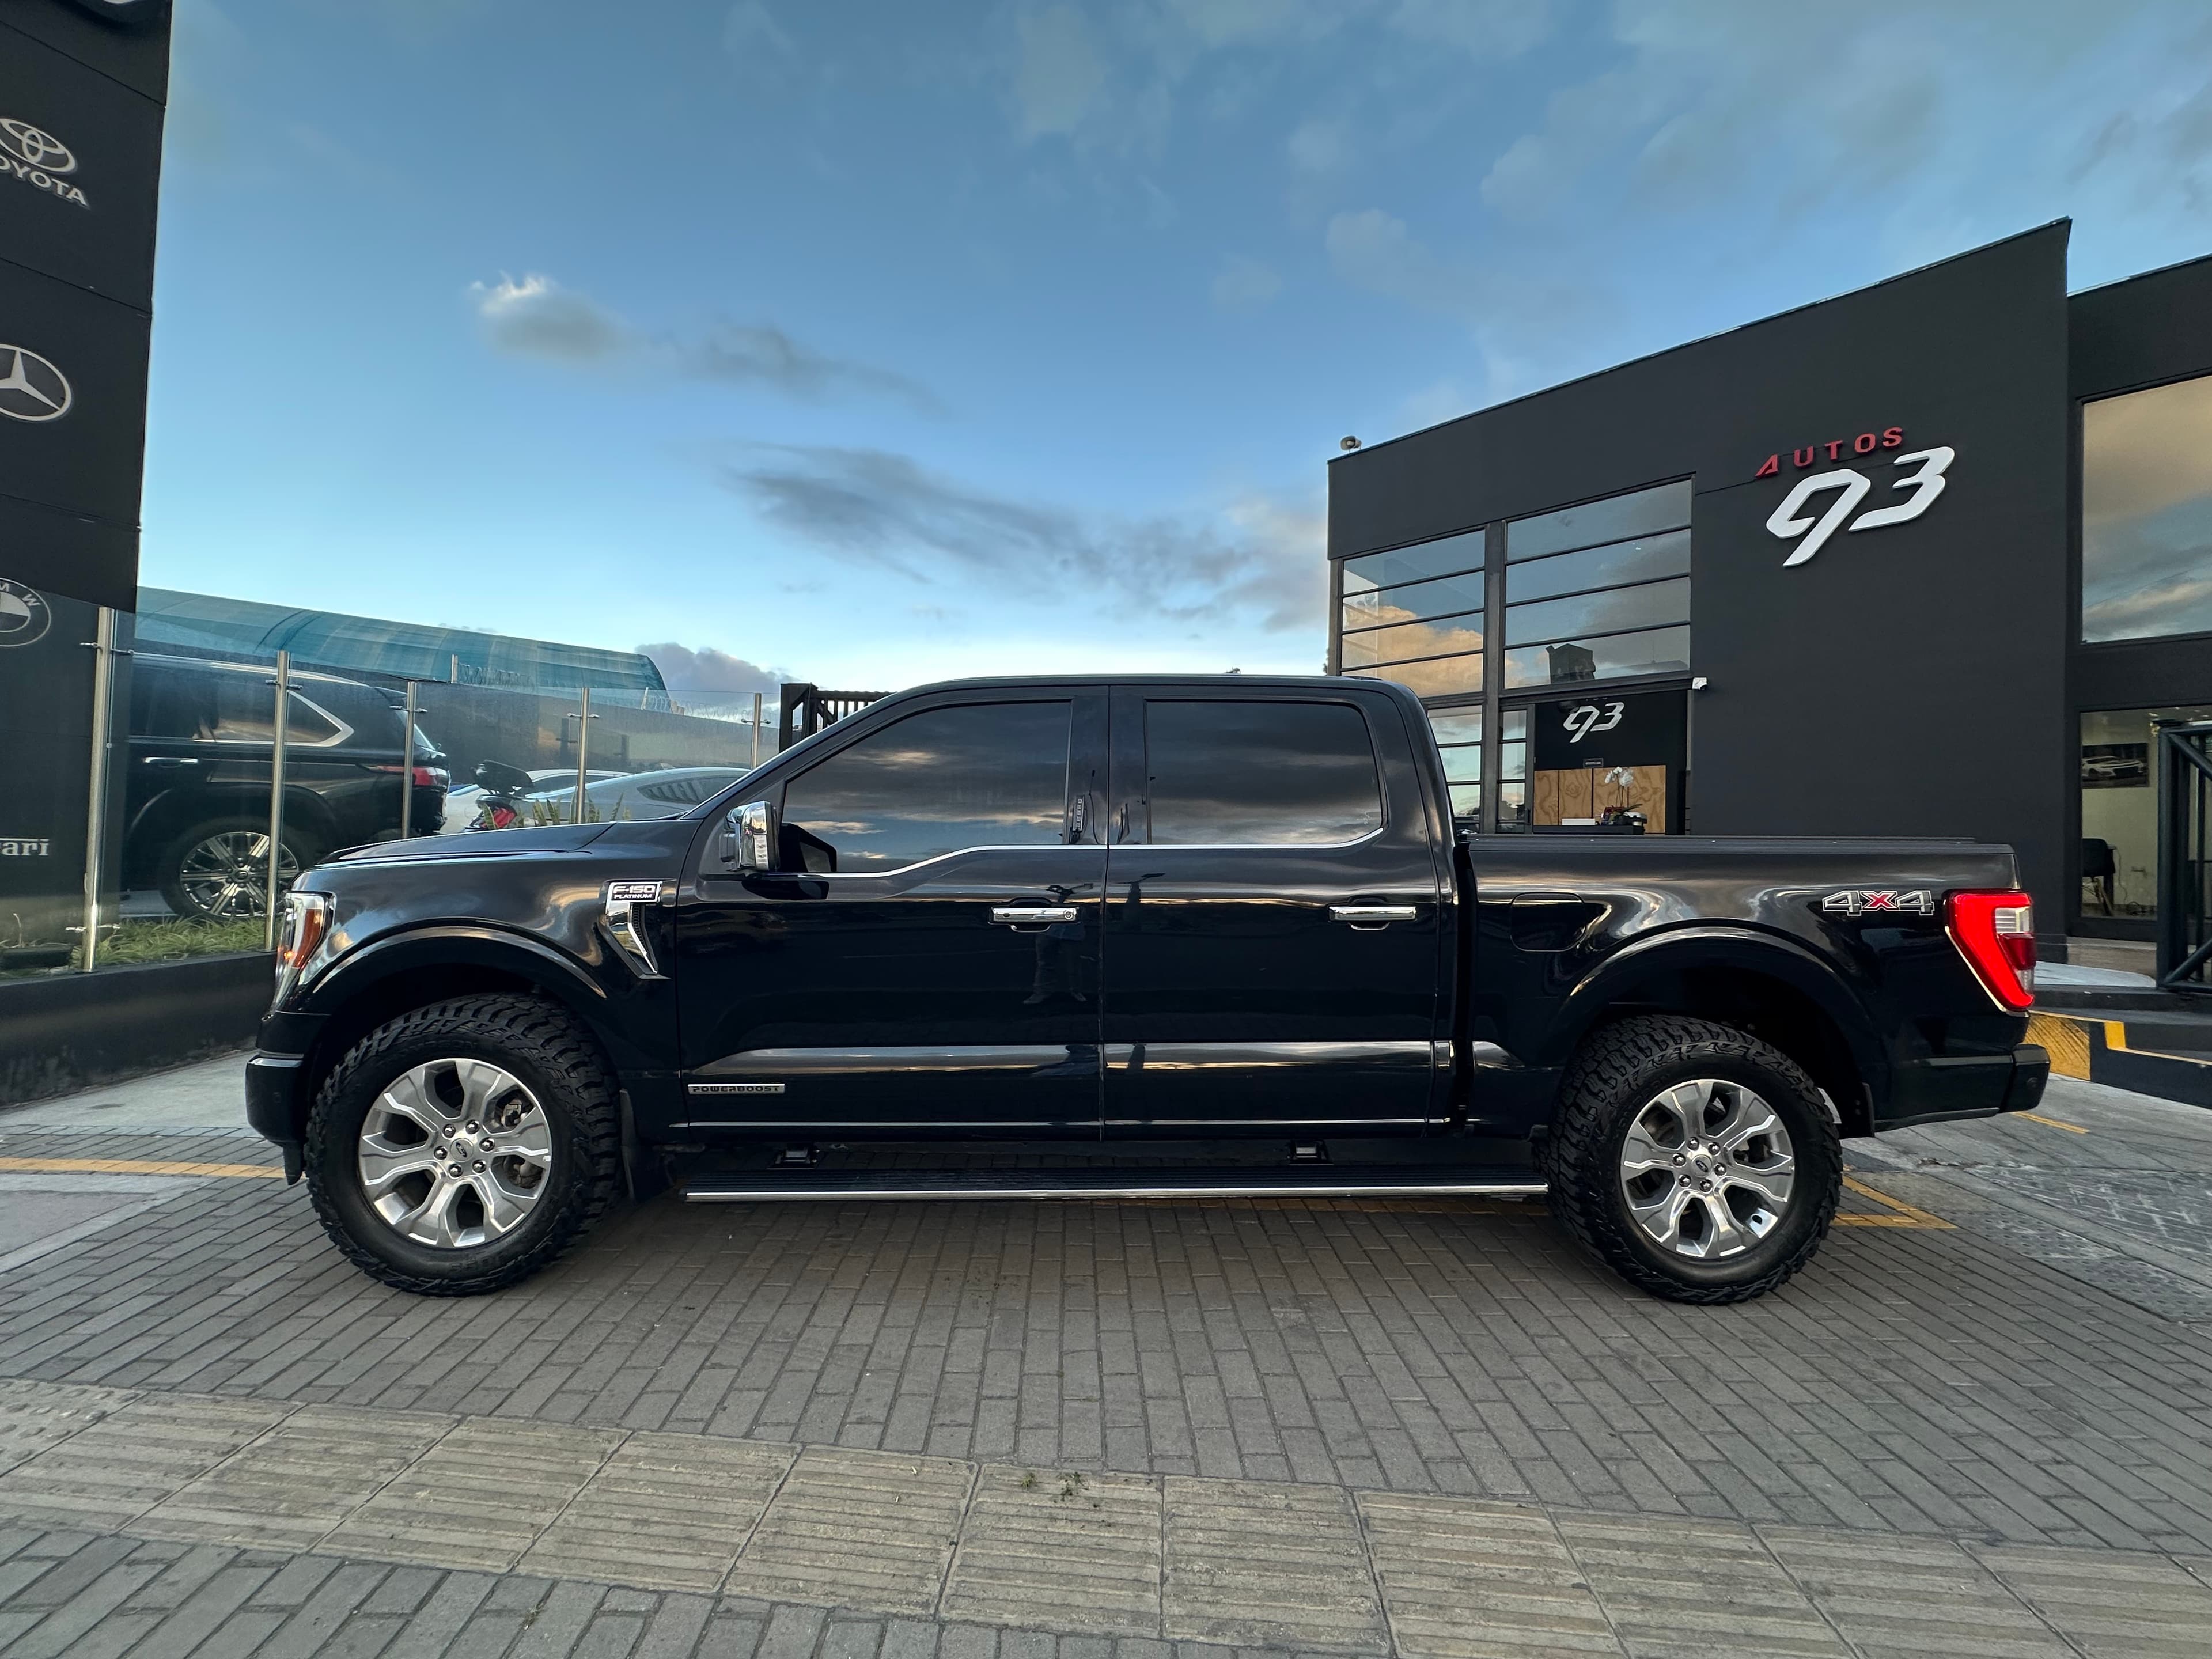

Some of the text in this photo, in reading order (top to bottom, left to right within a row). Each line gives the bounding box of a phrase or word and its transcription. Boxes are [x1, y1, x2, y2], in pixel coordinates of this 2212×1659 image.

[1755, 426, 1903, 479] AUTOS
[1766, 446, 1955, 567] 93
[1563, 702, 1624, 743] 93
[0, 838, 50, 856] ari
[613, 885, 656, 893] F-150
